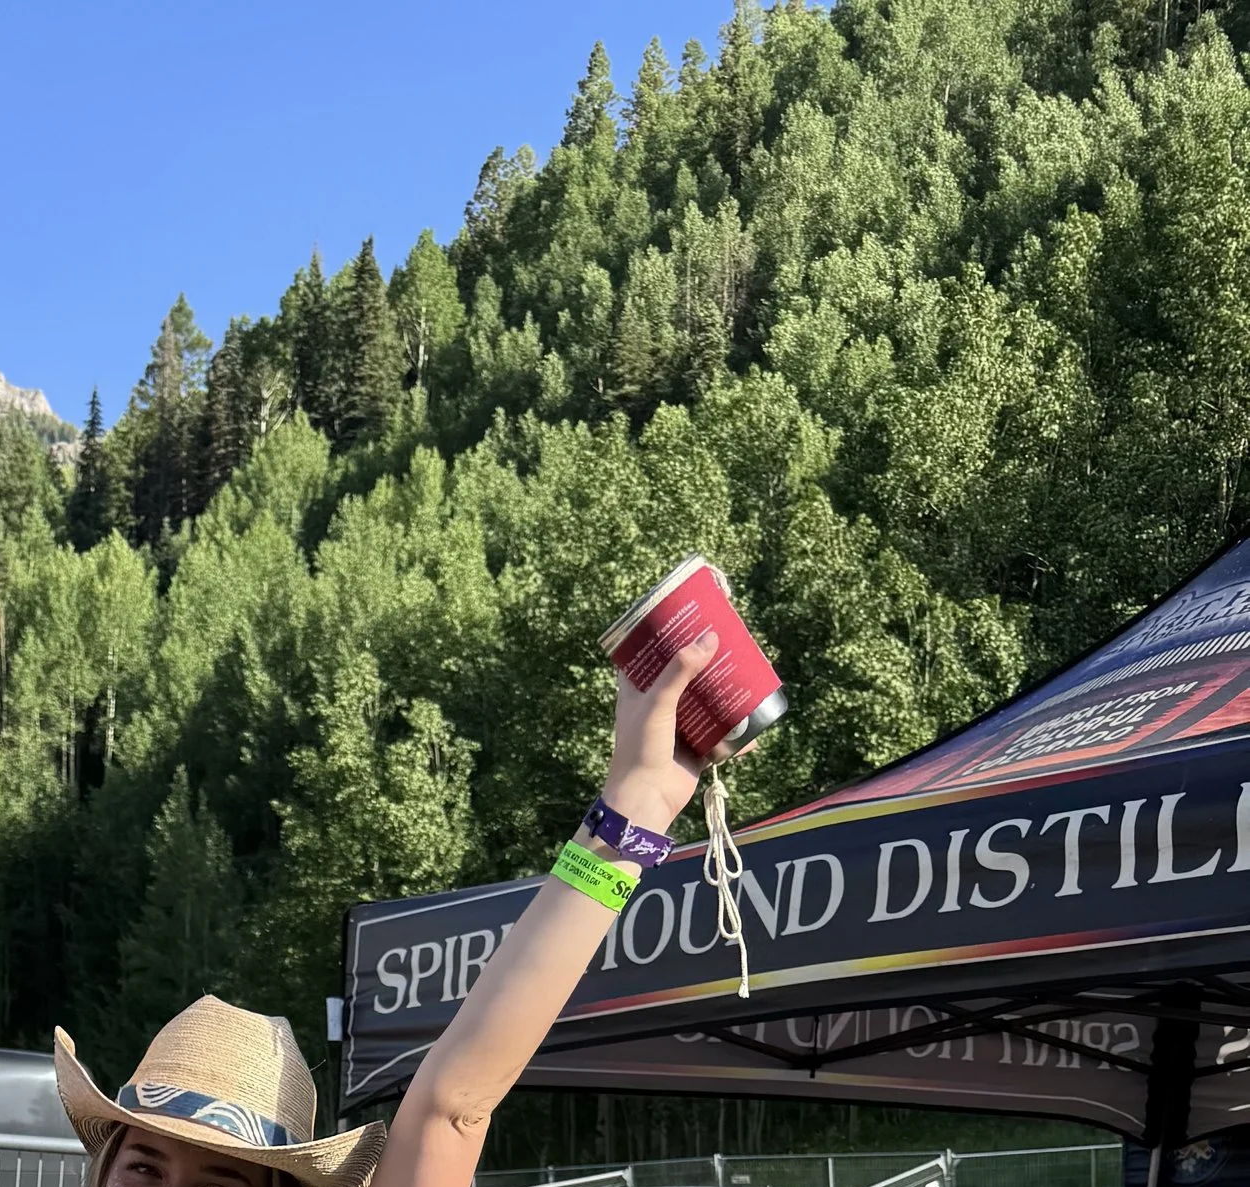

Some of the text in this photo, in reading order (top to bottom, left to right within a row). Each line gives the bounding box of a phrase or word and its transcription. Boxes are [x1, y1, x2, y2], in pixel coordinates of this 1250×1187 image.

[1005, 703, 1154, 754] COLORFUL
[1014, 682, 1198, 744] WHISKY FROM
[962, 726, 1134, 777] COLORADO
[373, 923, 512, 1015] SPIR
